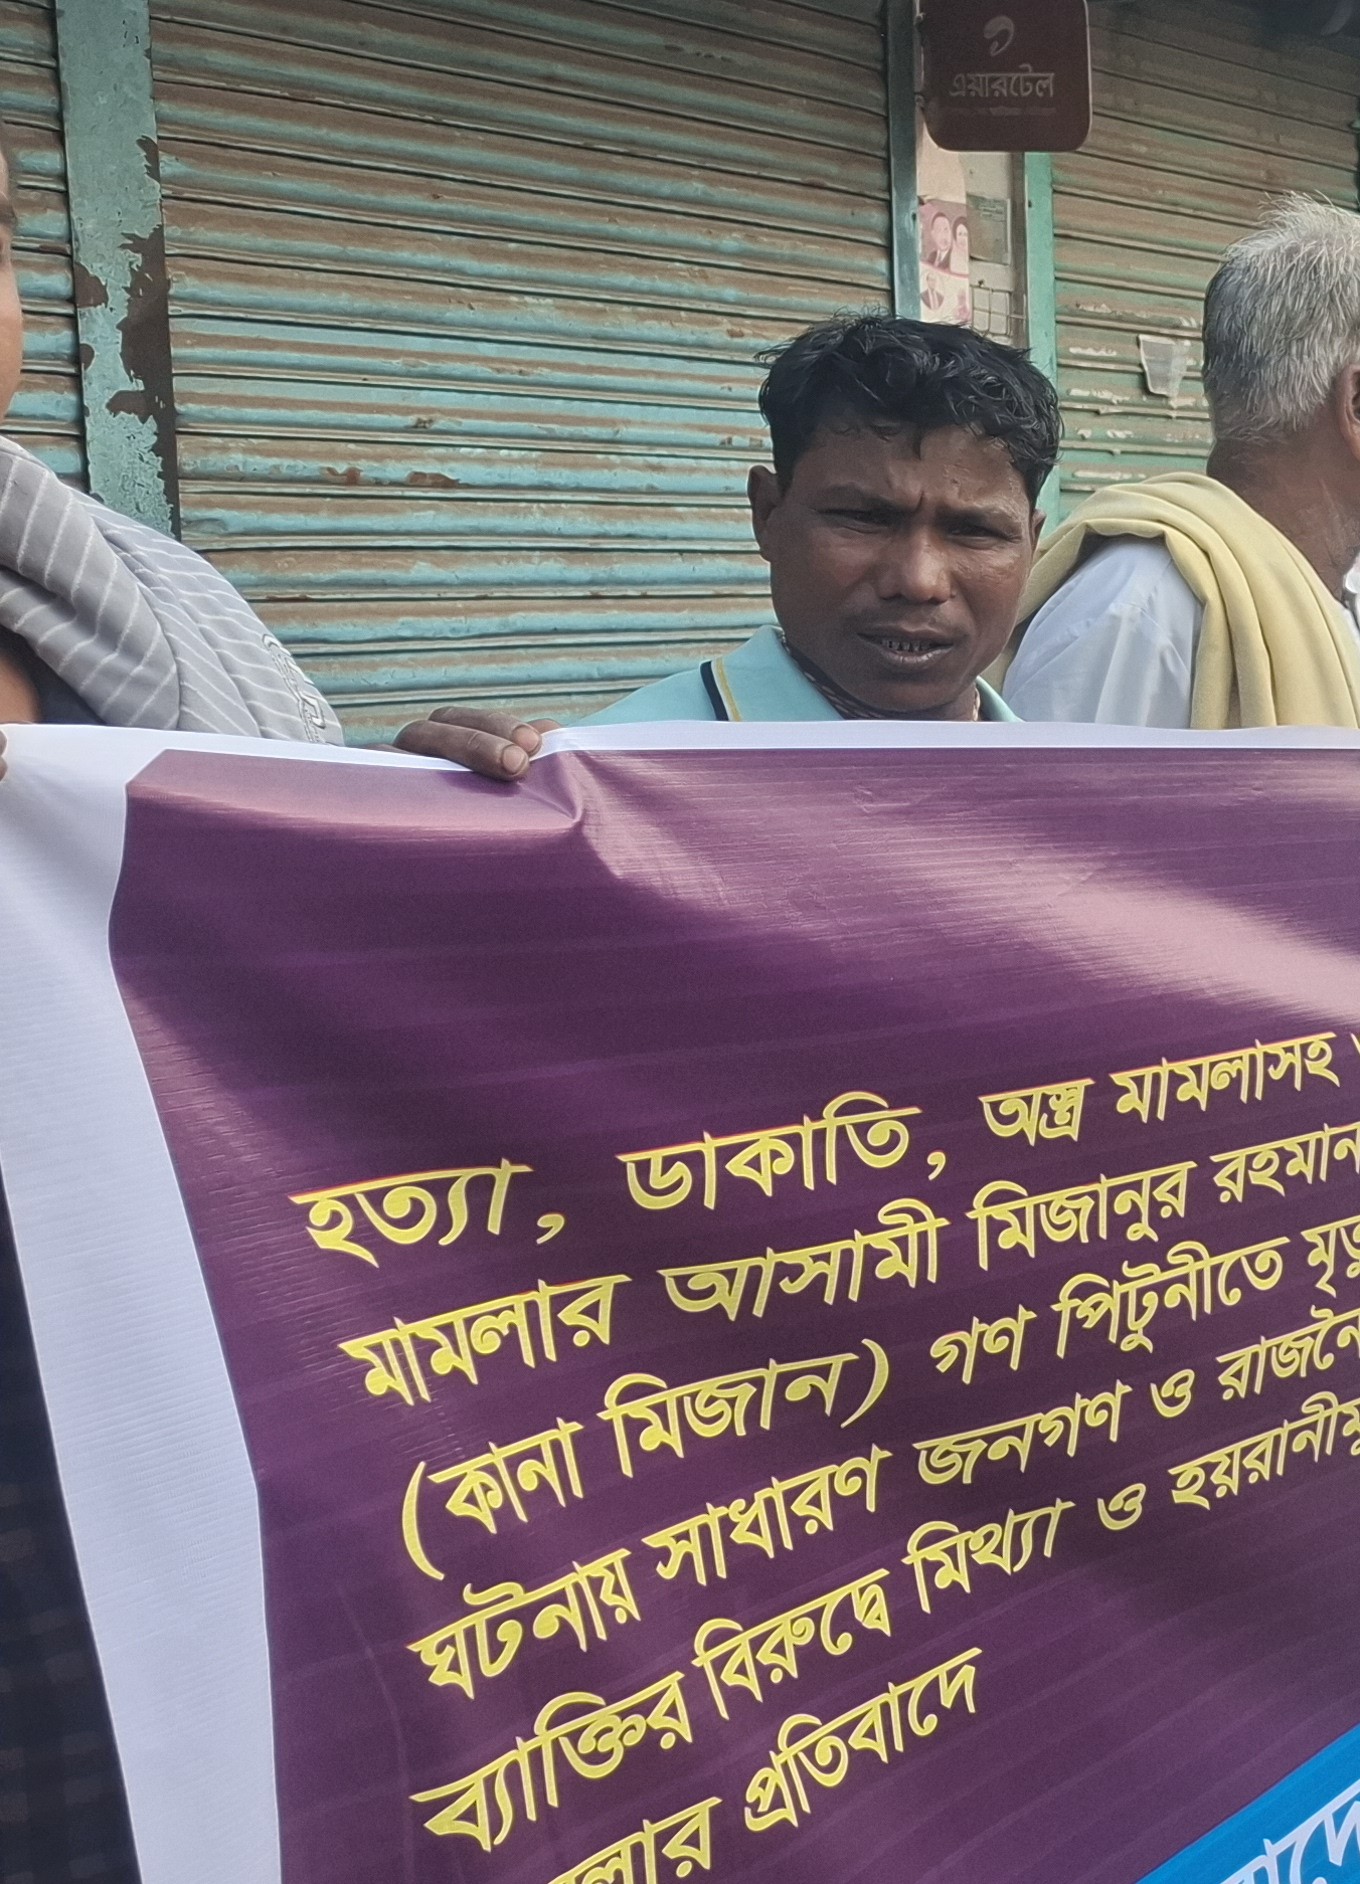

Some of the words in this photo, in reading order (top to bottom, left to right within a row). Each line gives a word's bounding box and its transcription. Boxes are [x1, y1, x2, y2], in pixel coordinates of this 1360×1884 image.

[950, 64, 1055, 98] এয়ারটেল
[293, 1160, 567, 1265] হত্যা,
[620, 1090, 948, 1212] ডাকাতি,
[979, 1077, 1095, 1146] অস্ত্র
[1109, 1032, 1340, 1122] মামলাসহ
[340, 1273, 631, 1405] মামলার
[661, 1197, 951, 1320] আসামী
[966, 1161, 1198, 1270] মিজানুর
[402, 1418, 584, 1580] (কানা
[599, 1339, 891, 1477] মিজান)
[930, 1306, 1037, 1384] গণ
[1052, 1235, 1291, 1357] পিটুনীতে
[407, 1547, 640, 1699] ঘটনায়
[642, 1443, 893, 1586] সাধারণ
[912, 1384, 1132, 1486] জনগণ
[1151, 1369, 1196, 1419] ও
[410, 1670, 693, 1852] ব্যাক্তির
[691, 1567, 893, 1721] বিরুদ্ধে
[902, 1501, 1075, 1614] মিথ্যা
[1098, 1482, 1146, 1532] ও
[548, 1797, 722, 1884] লার
[744, 1647, 983, 1833] প্রতিবাদে
